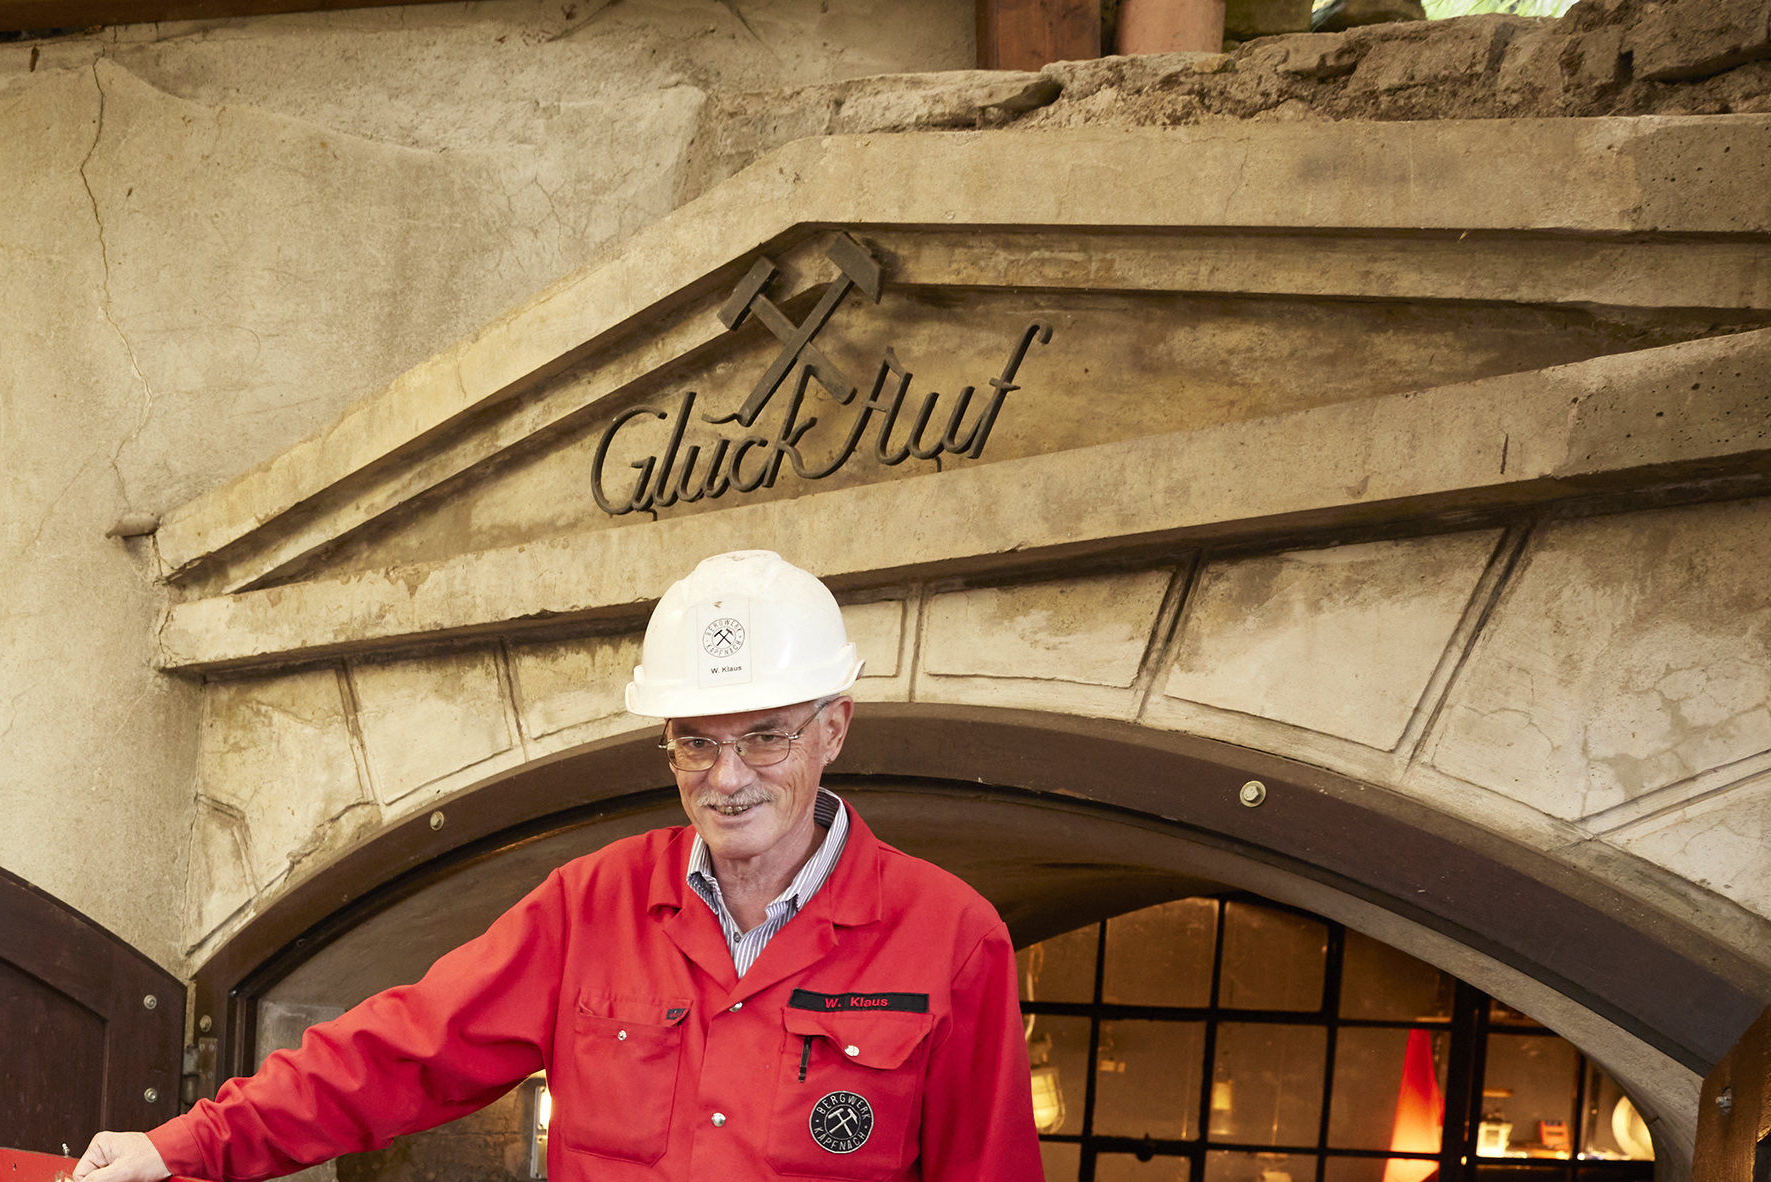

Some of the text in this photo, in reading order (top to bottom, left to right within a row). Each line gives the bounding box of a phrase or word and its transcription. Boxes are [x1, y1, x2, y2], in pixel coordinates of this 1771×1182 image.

[722, 665, 742, 673] Klaus
[825, 996, 889, 1009] W. Klaus
[816, 1093, 871, 1120] BERGWERK
